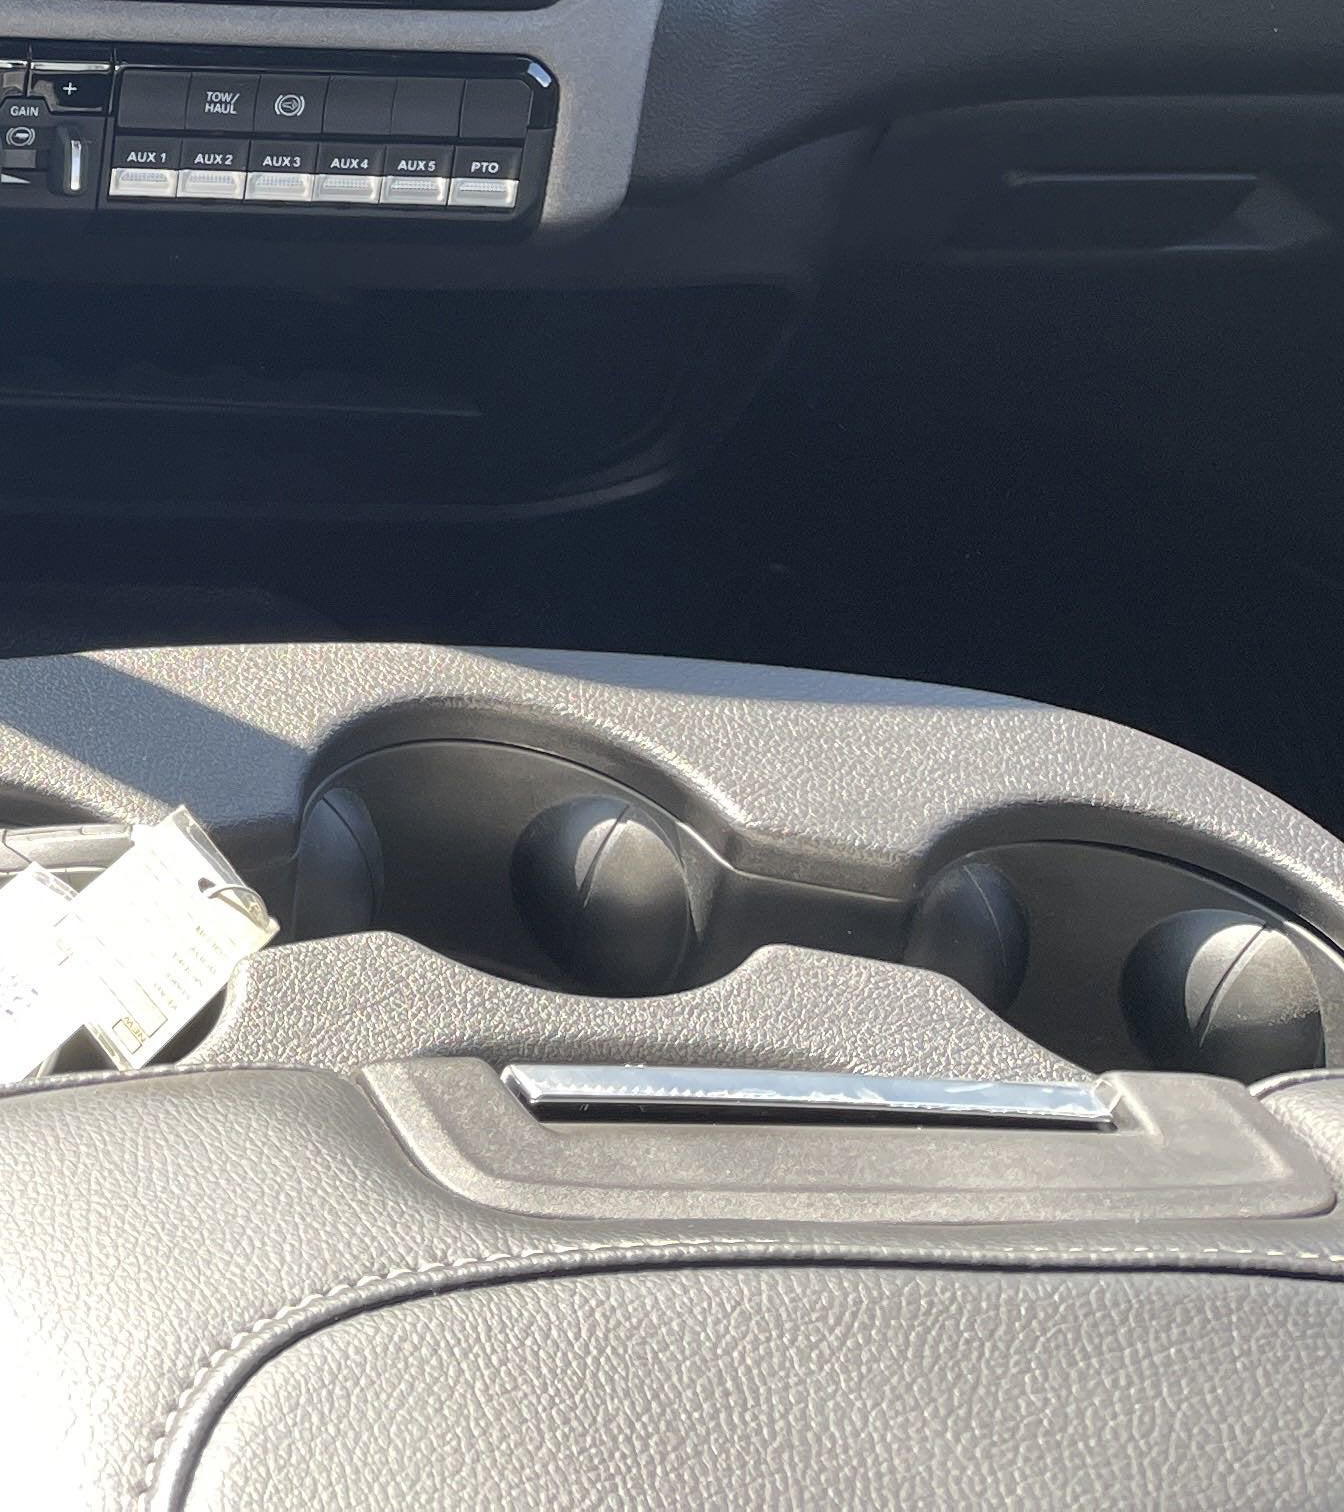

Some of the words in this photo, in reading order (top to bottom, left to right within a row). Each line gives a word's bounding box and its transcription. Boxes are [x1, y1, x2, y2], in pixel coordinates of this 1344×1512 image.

[205, 92, 241, 104] TOW/
[10, 106, 39, 117] GAIN
[204, 102, 238, 115] HAUL
[127, 151, 159, 163] AUX
[160, 152, 167, 163] 1
[194, 154, 223, 165] AUX
[224, 155, 234, 165] 2
[262, 156, 293, 167] AUX
[293, 157, 301, 167] 3
[330, 158, 360, 169] AUX
[360, 159, 369, 169] 4
[398, 160, 428, 171] AUX
[428, 161, 436, 172] 5
[471, 162, 499, 174] PTO
